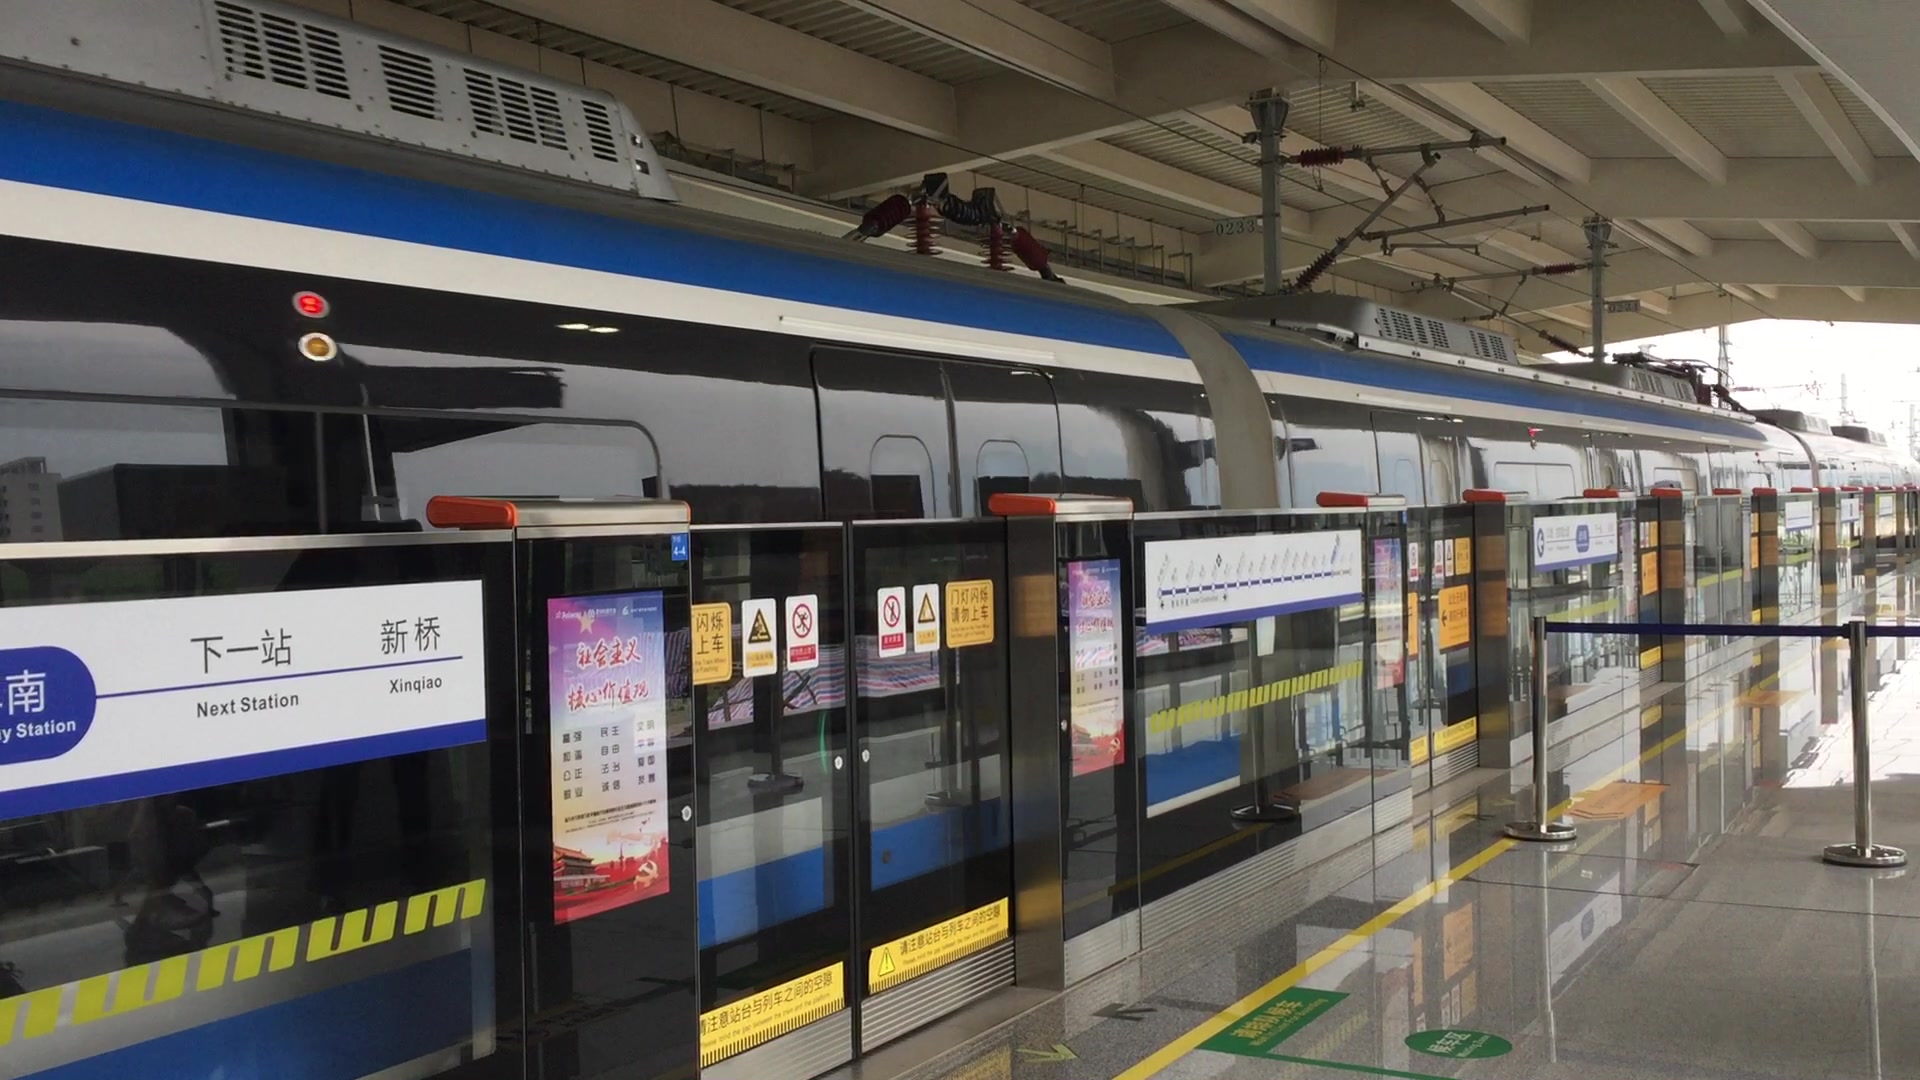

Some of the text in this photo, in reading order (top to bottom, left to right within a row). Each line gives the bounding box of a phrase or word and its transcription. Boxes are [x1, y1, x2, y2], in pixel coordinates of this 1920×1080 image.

[1216, 220, 1255, 236] 0233
[951, 586, 989, 605] 门灯闪烁
[696, 611, 724, 633] 闪烁
[951, 605, 989, 624] 请勿上车
[380, 616, 441, 657] 新桥
[696, 633, 724, 655] 上车
[190, 627, 293, 674] 下一站
[577, 638, 641, 668] 社会主义
[0, 669, 46, 716] 南
[389, 674, 443, 694] Xinqiao
[568, 680, 649, 711] 核心价值观
[196, 691, 299, 718] Next Station
[16, 720, 76, 739] Station
[900, 903, 1001, 956] 请注意站台与列车之间的空隙
[1426, 1031, 1472, 1054] 候车区
